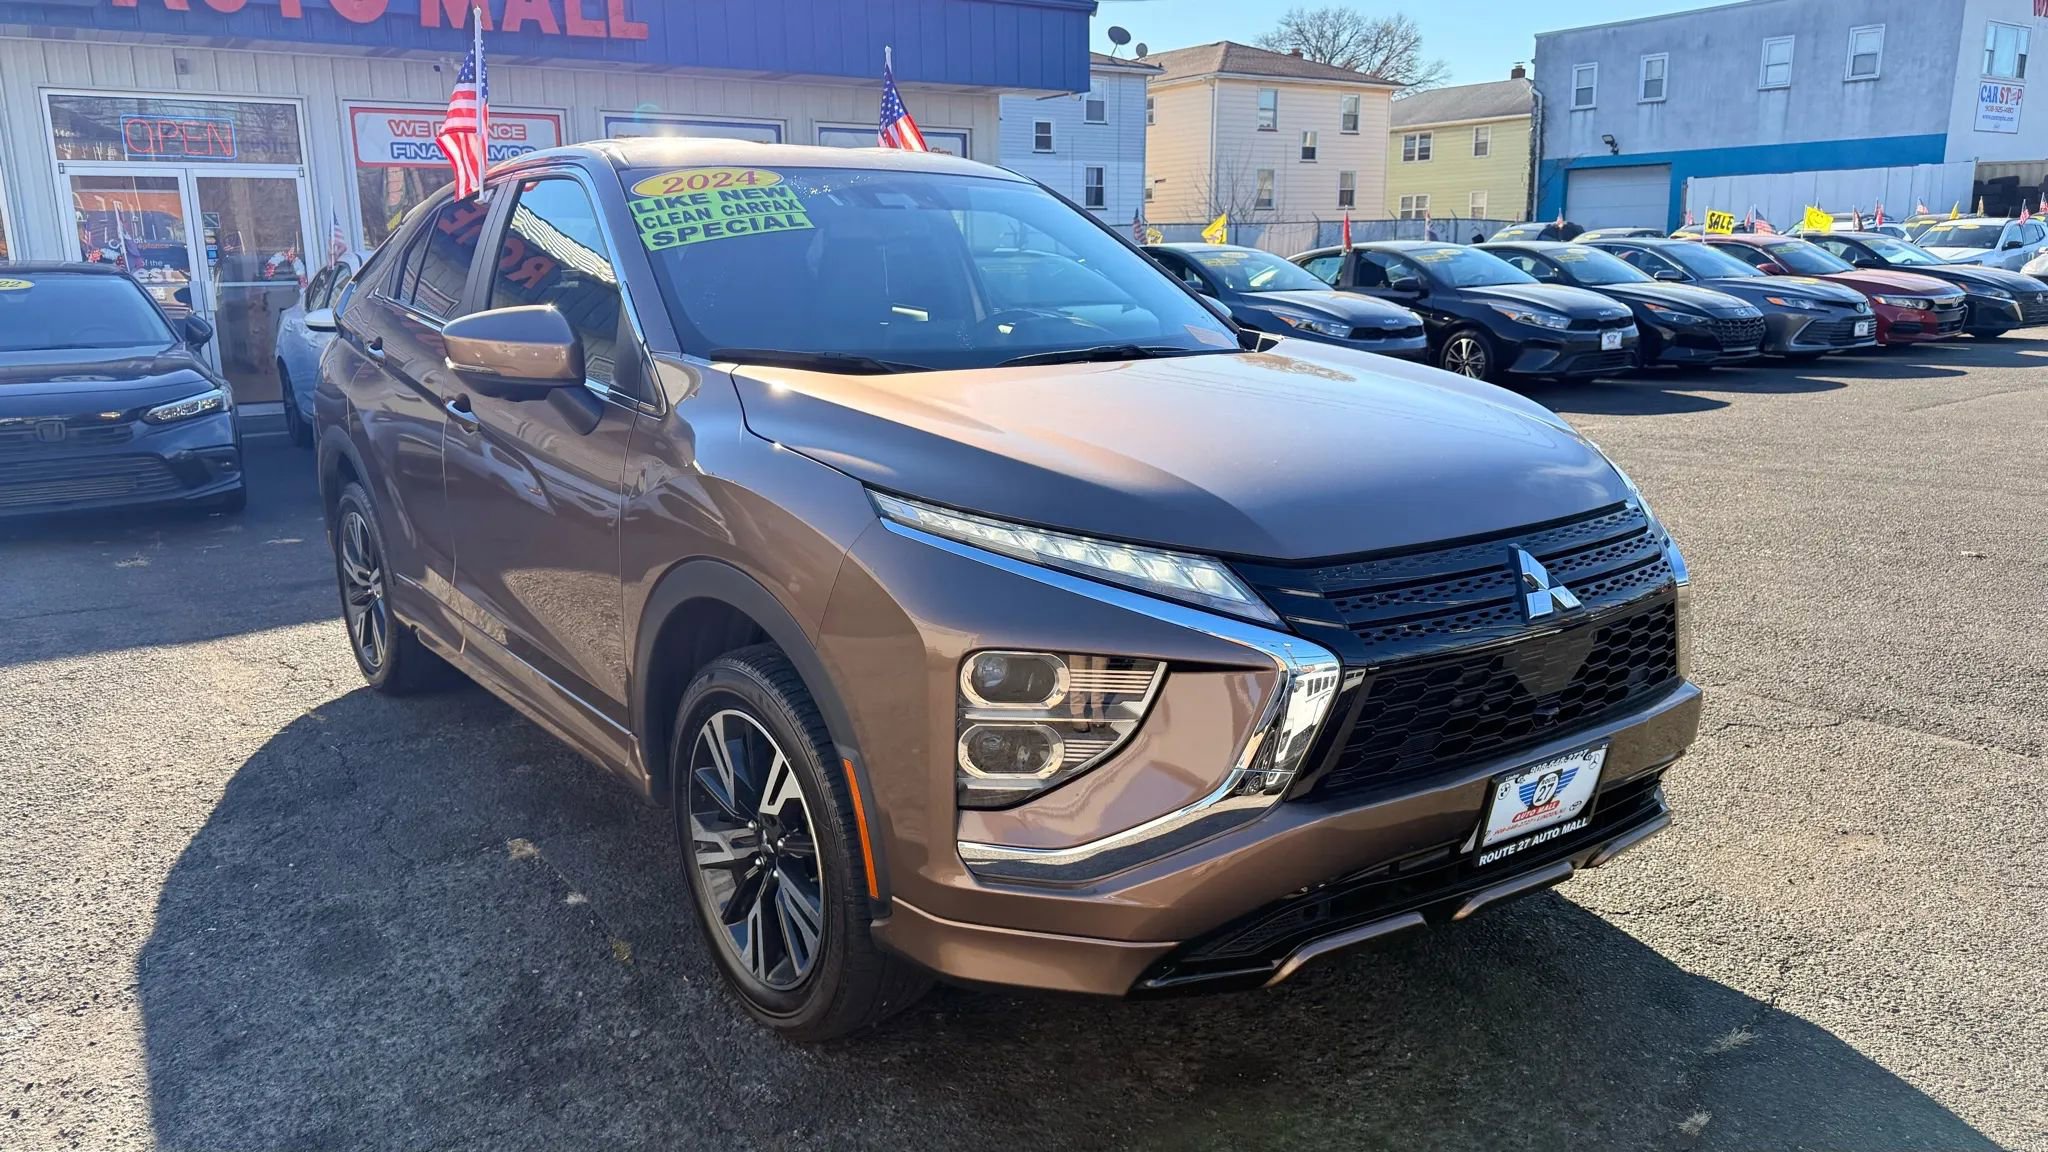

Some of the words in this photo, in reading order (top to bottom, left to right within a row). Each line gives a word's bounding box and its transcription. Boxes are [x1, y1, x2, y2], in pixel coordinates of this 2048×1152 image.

[1980, 84, 1999, 103] CAR
[125, 118, 233, 156] OPEN
[388, 119, 431, 138] WE
[662, 171, 759, 194] 2024
[633, 192, 712, 215] LIKE
[717, 186, 789, 202] NEW
[642, 207, 712, 230] CLEAN
[720, 199, 801, 217] CARFAX
[1707, 212, 1735, 231] SALE
[652, 214, 805, 247] SPECIAL
[1535, 782, 1555, 803] 27
[1513, 808, 1537, 821] AUTO
[1538, 801, 1559, 814] MALL
[1478, 844, 1516, 867] ROUTE
[1517, 839, 1530, 852] 27
[1531, 829, 1560, 846] AUTO
[1561, 818, 1588, 835] MALL
